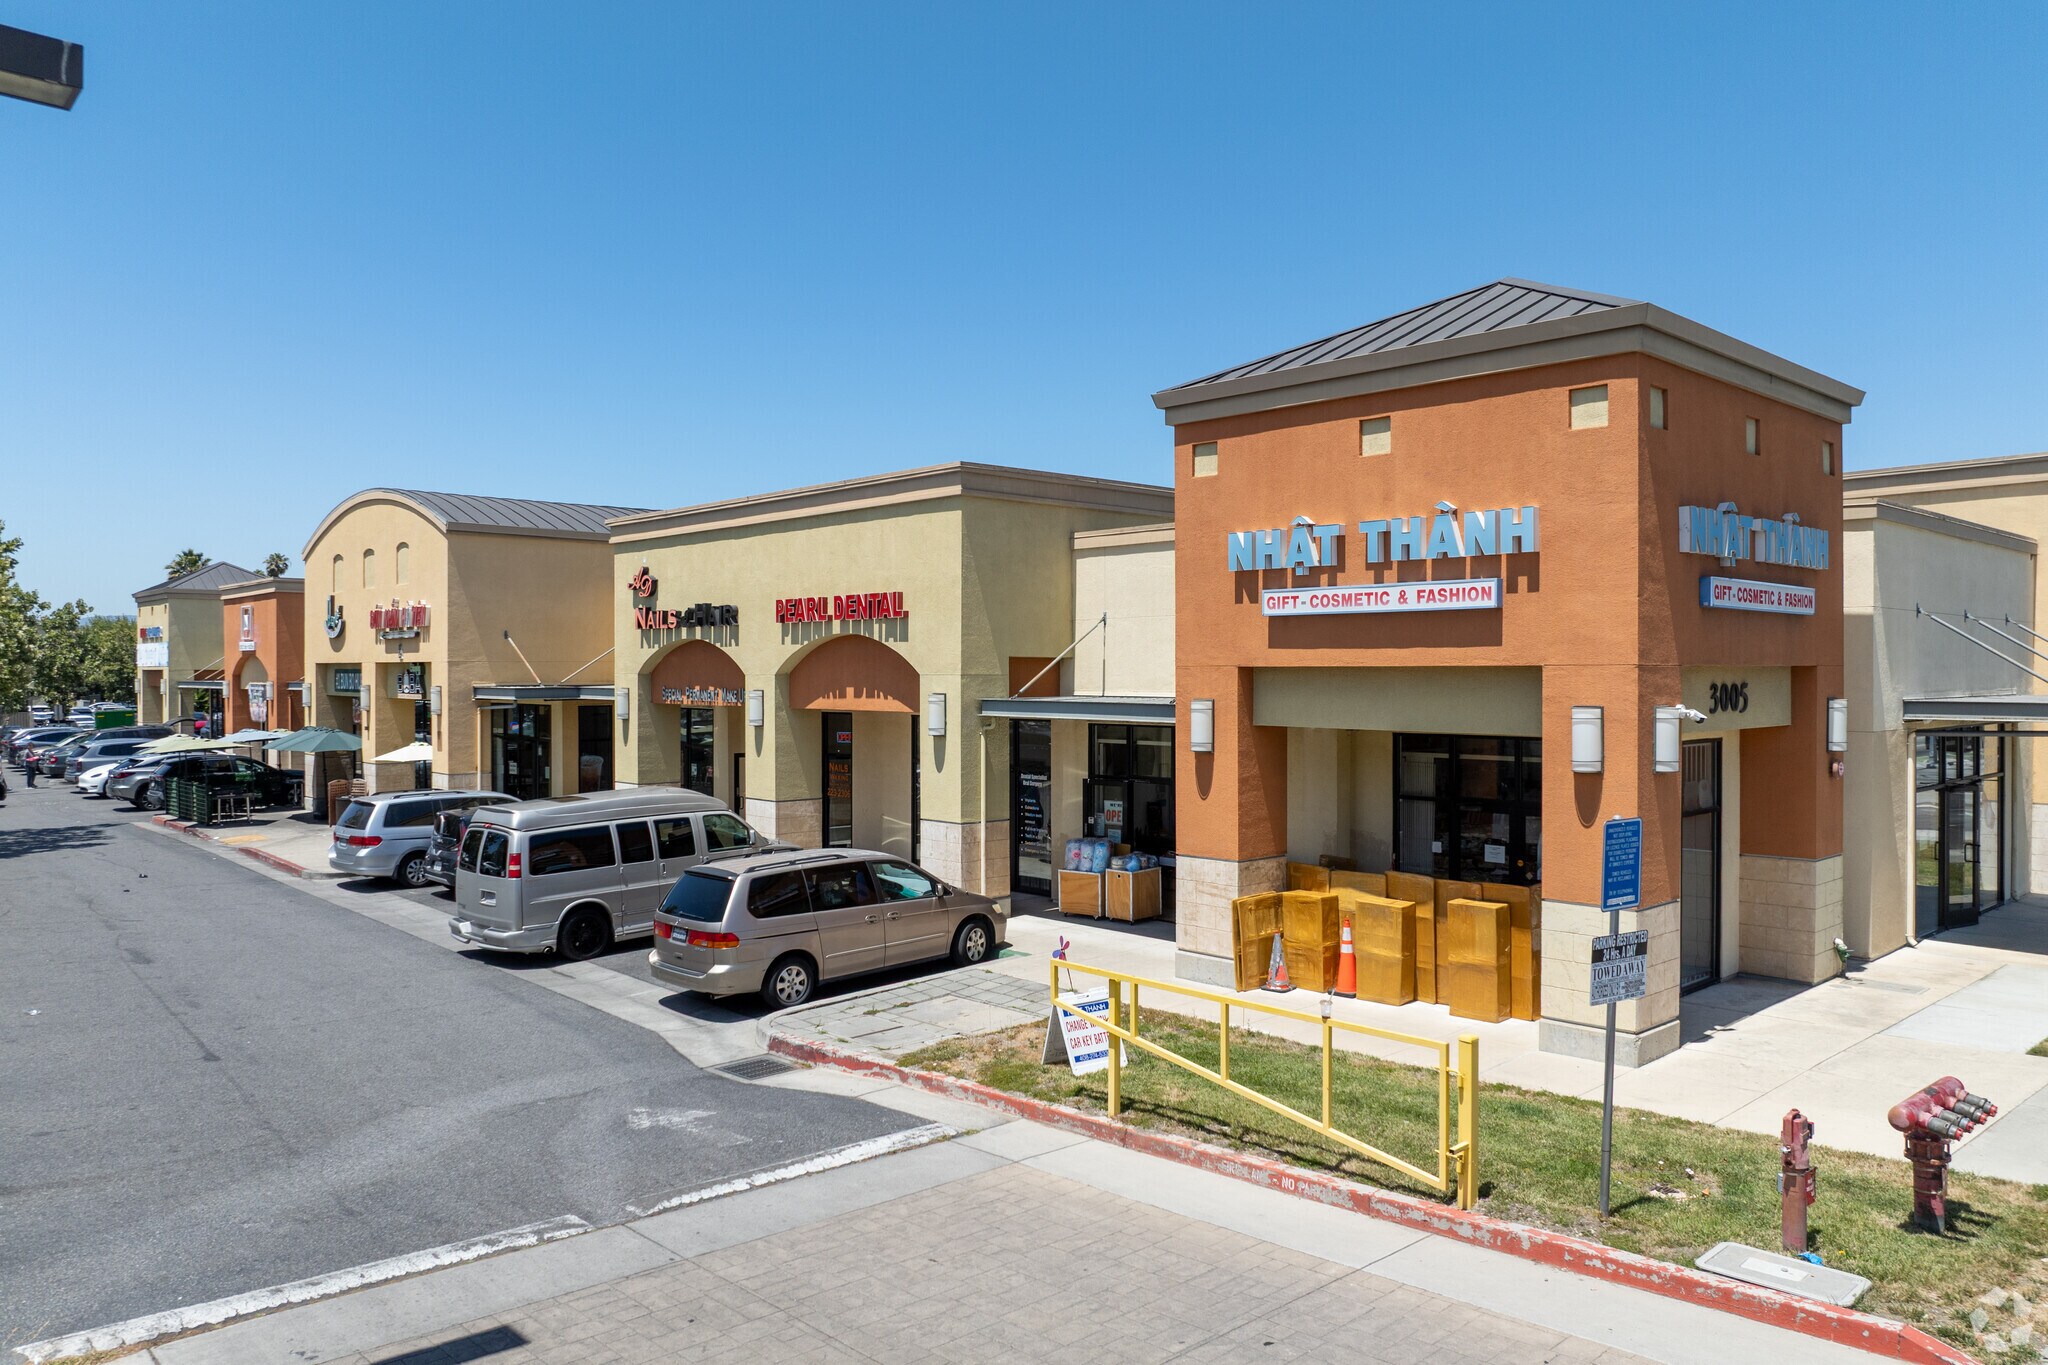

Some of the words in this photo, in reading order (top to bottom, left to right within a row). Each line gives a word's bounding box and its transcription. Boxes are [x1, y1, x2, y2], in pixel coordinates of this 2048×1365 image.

[1228, 515, 1344, 575] NHẬT
[1359, 500, 1539, 563] THÀNH
[1681, 502, 1753, 566] NHẬT
[1757, 513, 1829, 570] THÀNH
[1397, 590, 1408, 605] &
[1416, 586, 1492, 604] FASHION
[1777, 592, 1783, 605] &
[1784, 592, 1813, 609] FASHION
[635, 604, 679, 630] NAILS
[775, 597, 830, 623] PEARL
[833, 592, 904, 621] DENTAL
[662, 686, 682, 701] SPECIAL
[686, 687, 718, 702] PERMANENT
[721, 687, 738, 703] MAKE
[738, 688, 746, 703] U
[1709, 682, 1749, 714] 3005
[829, 762, 849, 773] NAILS
[1593, 935, 1616, 950] PARKING
[1616, 930, 1648, 946] RESTRICTED
[1603, 949, 1610, 961] 24
[1621, 946, 1626, 958] A
[1626, 944, 1637, 957] DAY
[1593, 964, 1622, 981] TOWED
[1622, 960, 1645, 976] AWAY
[1065, 1018, 1089, 1033] CHANGE
[1070, 1036, 1082, 1049] CAR
[1082, 1034, 1093, 1046] KEY
[1281, 1176, 1295, 1191] NO
